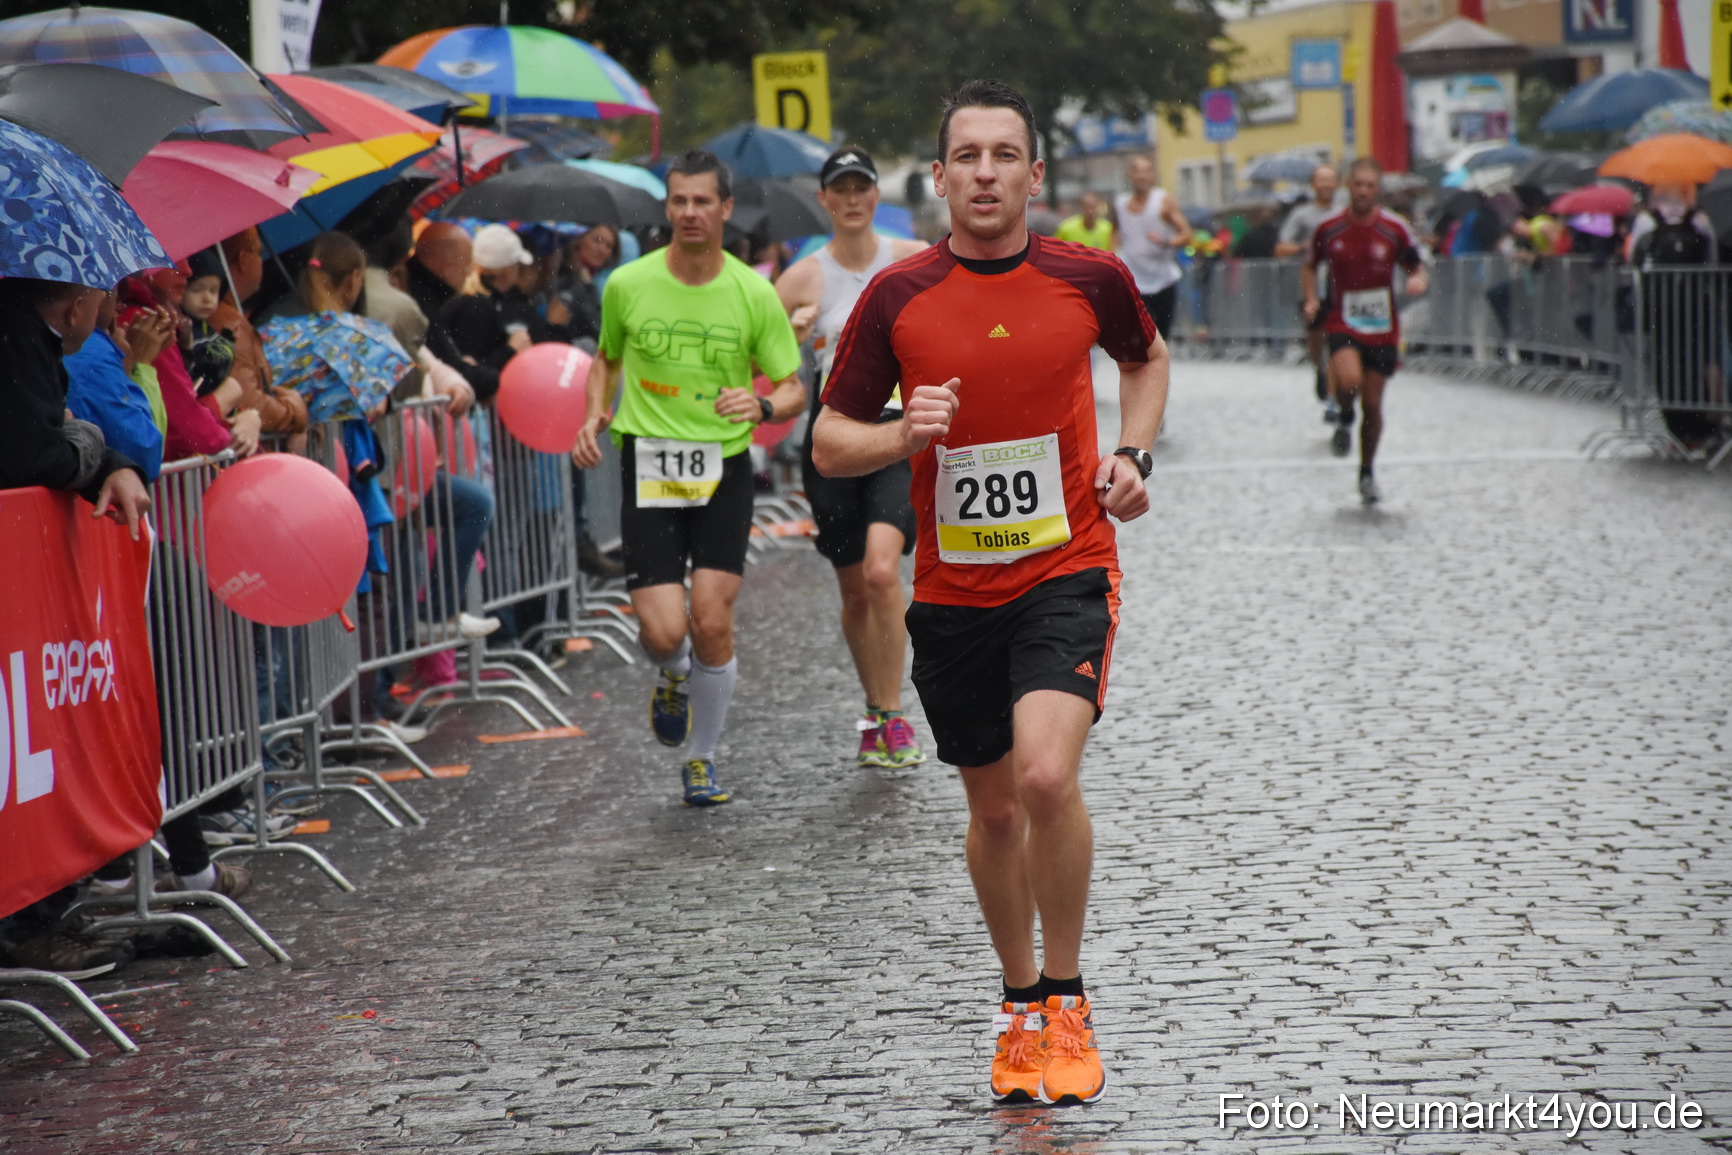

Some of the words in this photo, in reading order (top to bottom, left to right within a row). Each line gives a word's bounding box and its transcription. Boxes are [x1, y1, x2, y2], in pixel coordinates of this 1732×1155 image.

[777, 88, 811, 132] D
[655, 449, 705, 478] 118
[982, 441, 1047, 463] BOCK
[955, 470, 1039, 520] 289
[972, 530, 1031, 547] Tobias
[1074, 667, 1097, 680] adidas
